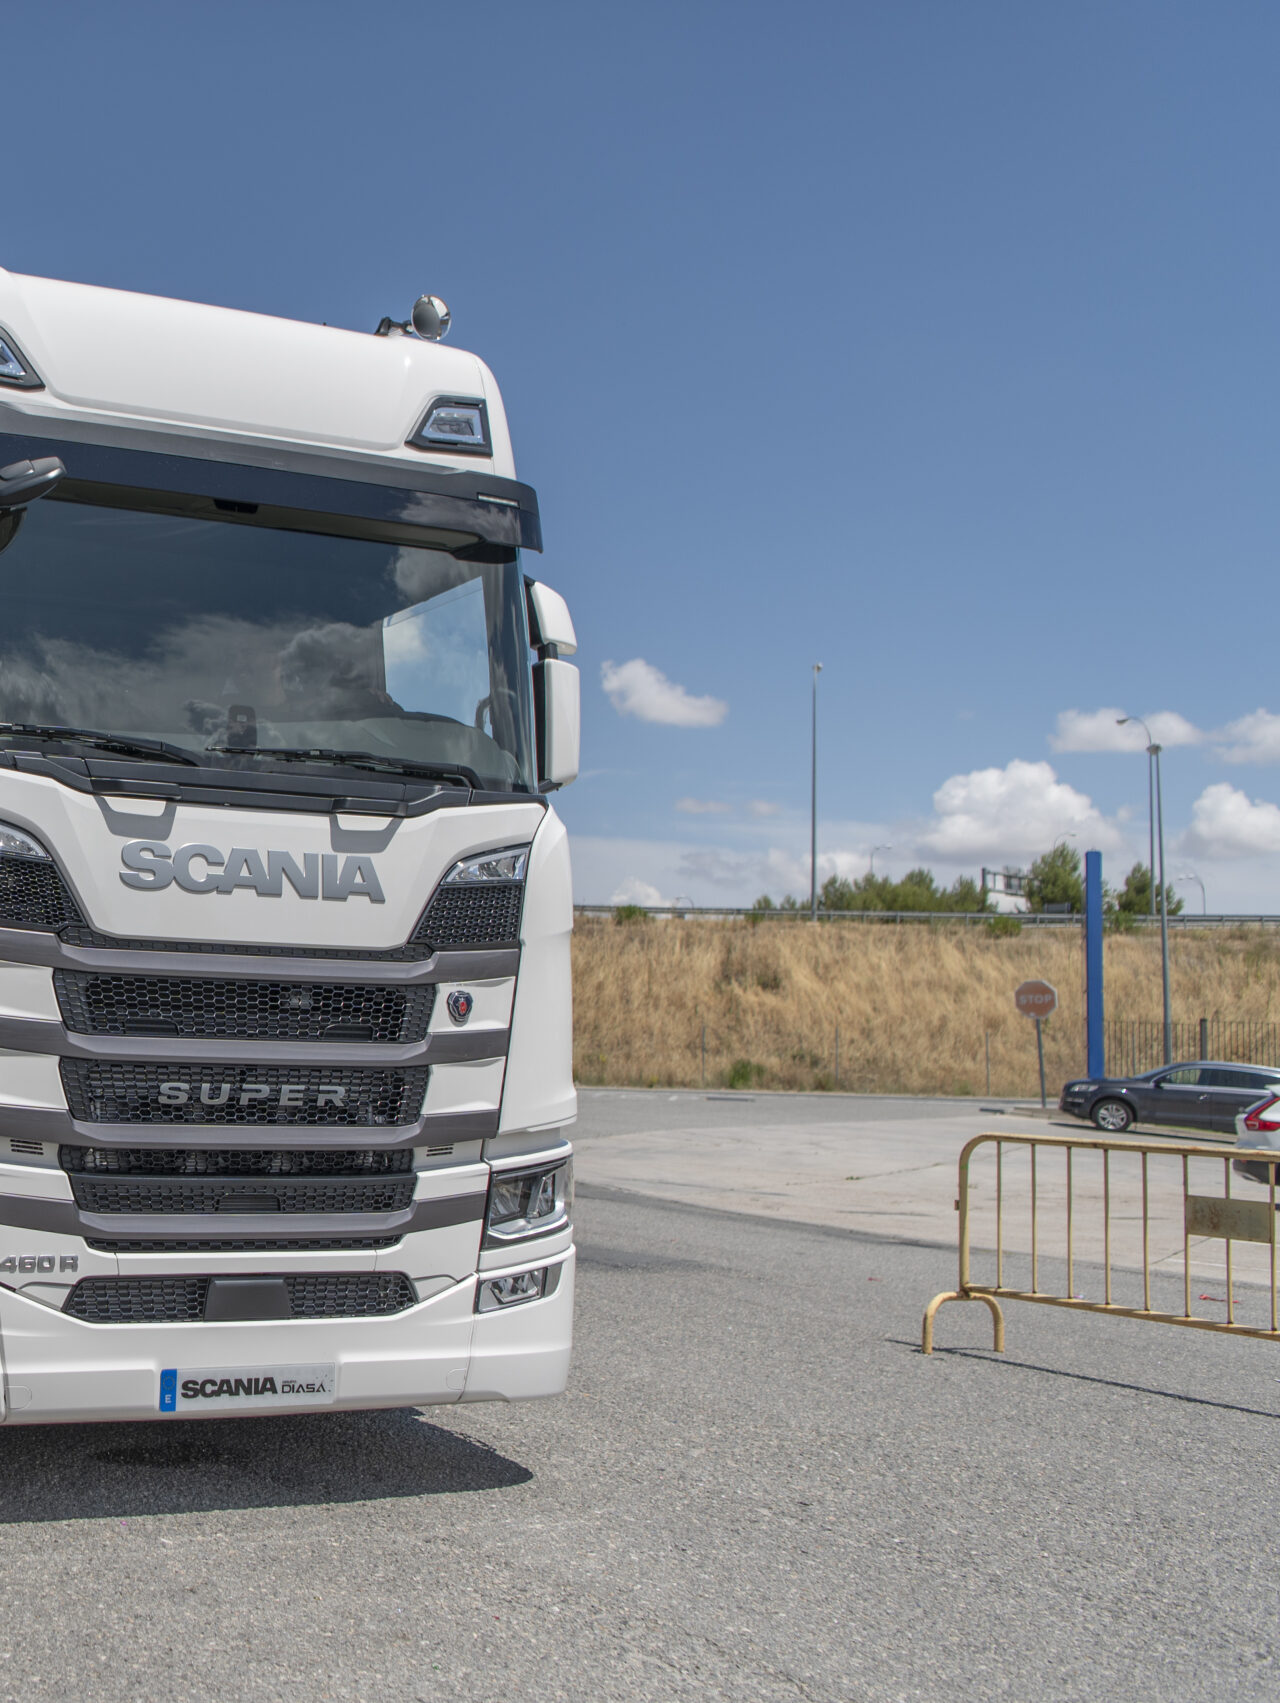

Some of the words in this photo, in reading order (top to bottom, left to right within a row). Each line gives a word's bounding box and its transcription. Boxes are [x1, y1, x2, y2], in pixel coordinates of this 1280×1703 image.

[119, 840, 386, 904] SCANIA
[1020, 994, 1053, 1005] STOP
[158, 1082, 346, 1107] SUPER
[0, 1255, 56, 1273] 460
[59, 1255, 79, 1273] R
[181, 1377, 278, 1399] SCANIA
[281, 1383, 326, 1394] DIASA
[165, 1394, 172, 1403] E
